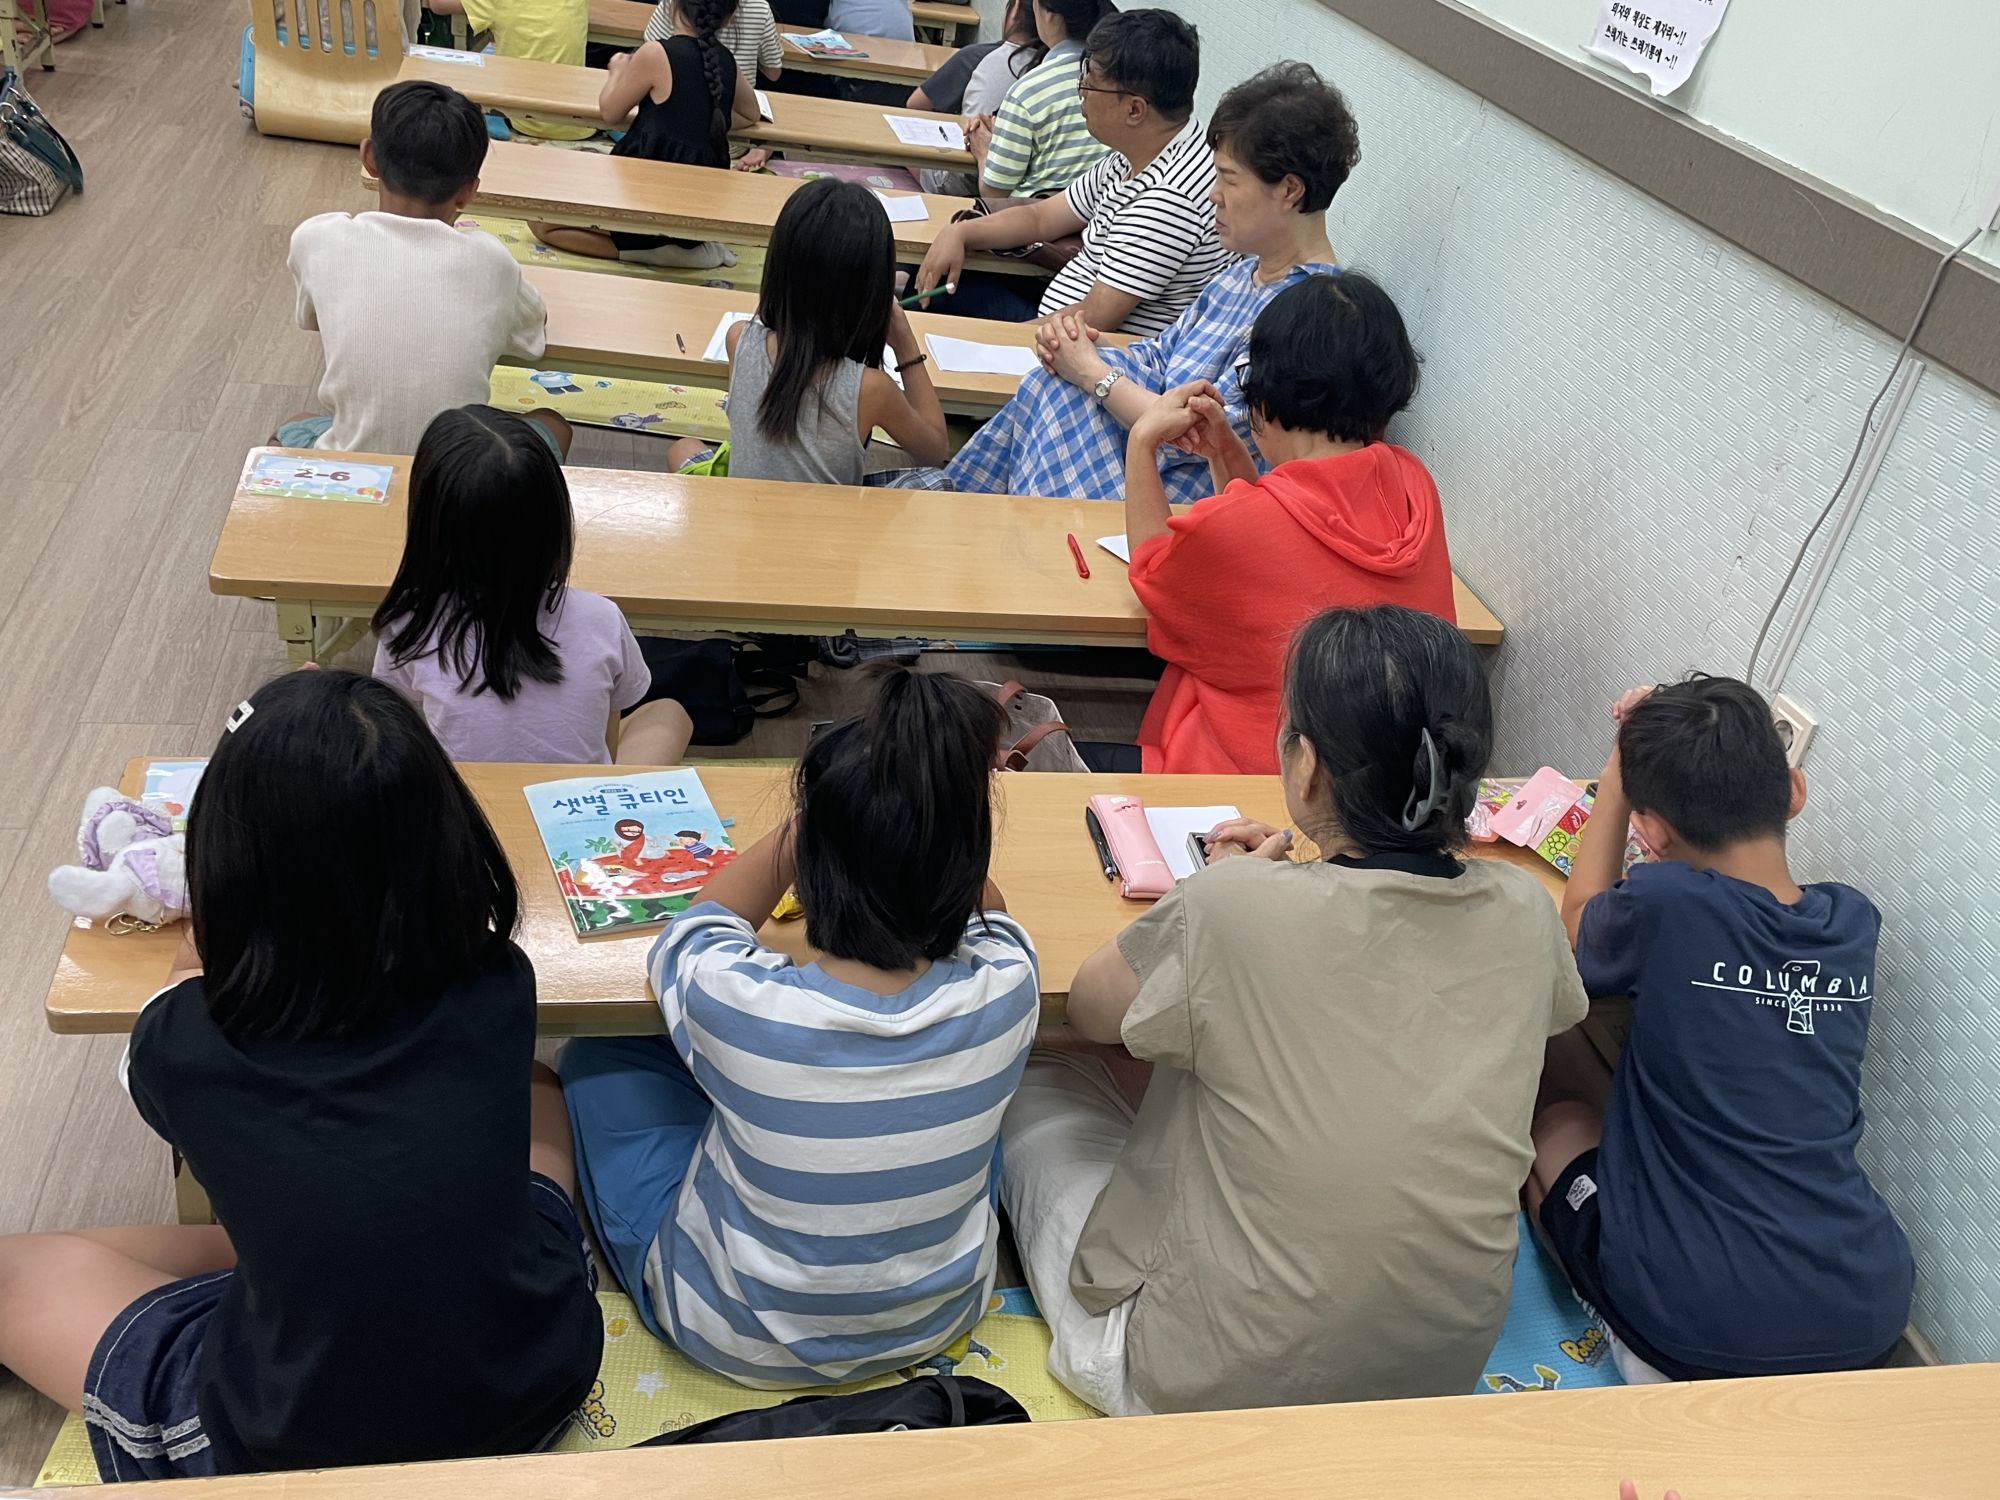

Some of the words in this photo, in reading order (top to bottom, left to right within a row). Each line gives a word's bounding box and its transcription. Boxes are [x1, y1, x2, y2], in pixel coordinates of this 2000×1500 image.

[1611, 2, 1631, 21] 의자와
[1632, 10, 1652, 30] 책상도
[1604, 24, 1628, 47] 쓰레기는
[1630, 37, 1663, 63] 쓰레기통에
[293, 467, 351, 482] 2-6
[552, 792, 610, 816] 샛별
[617, 787, 689, 810] 큐티인
[1712, 961, 1868, 996] COLUMBIA
[1754, 996, 1787, 1008] SINCE
